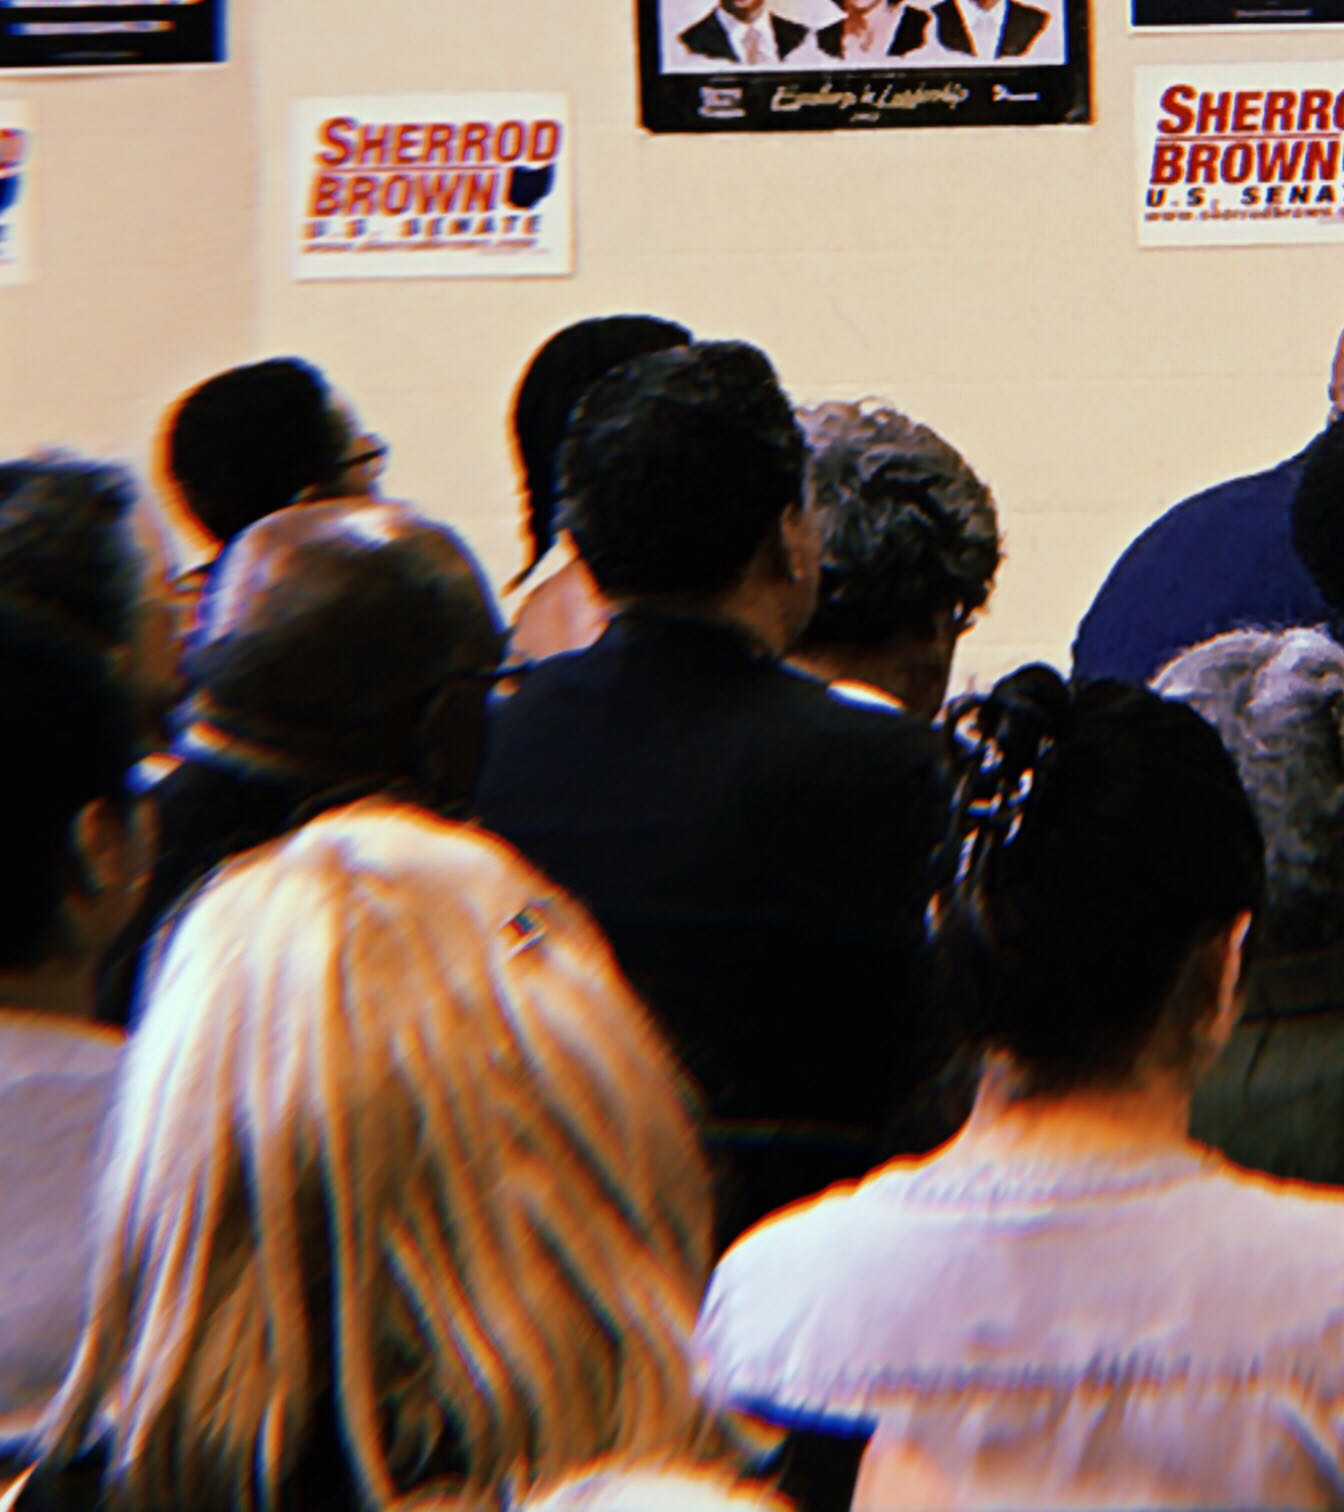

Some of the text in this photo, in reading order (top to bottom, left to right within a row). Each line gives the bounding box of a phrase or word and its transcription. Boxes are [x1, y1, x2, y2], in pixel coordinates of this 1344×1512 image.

[313, 116, 562, 168] SHERROD
[1149, 140, 1341, 185] BROWN
[307, 173, 499, 217] BROWN
